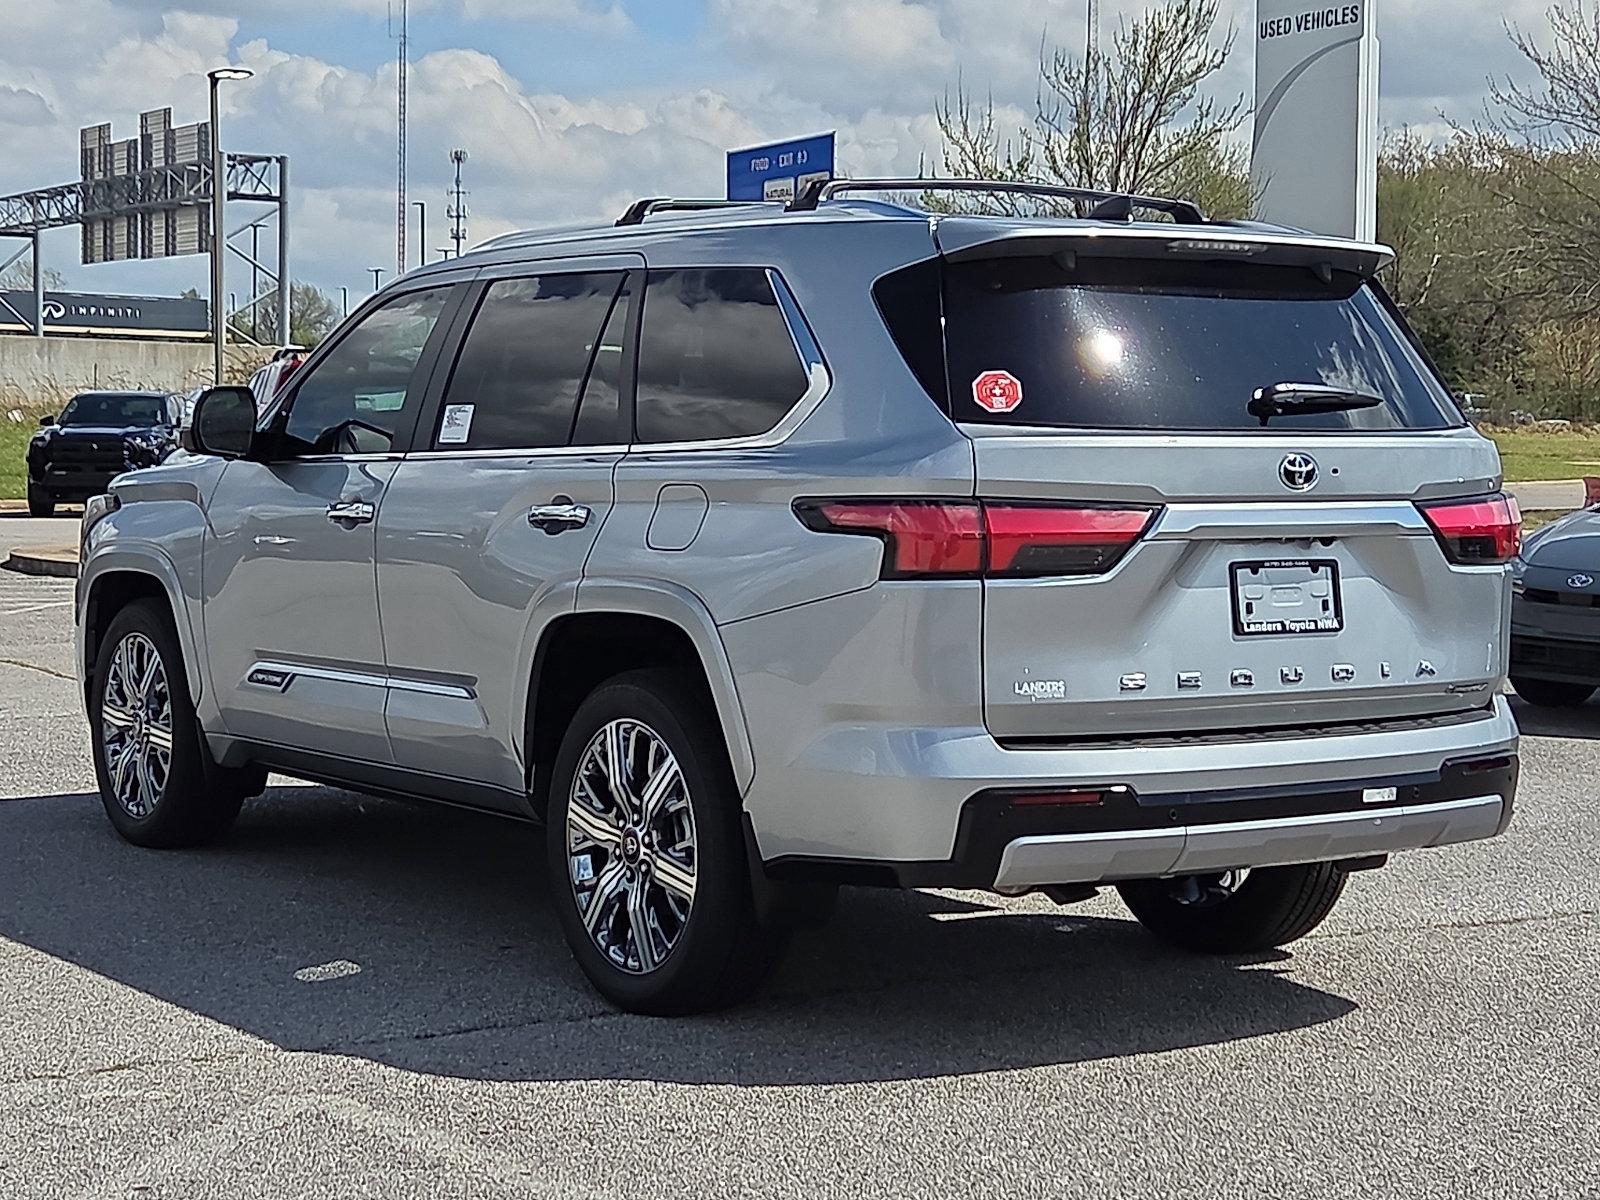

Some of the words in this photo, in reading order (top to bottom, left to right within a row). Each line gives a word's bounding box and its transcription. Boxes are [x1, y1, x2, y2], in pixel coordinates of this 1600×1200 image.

[1260, 17, 1292, 39] USED
[1295, 5, 1359, 32] VEHICLES
[70, 305, 142, 319] INFINITI
[1243, 621, 1282, 633] Landers
[1283, 620, 1316, 633] Toyota
[1317, 618, 1340, 630] NWA
[1118, 659, 1437, 692] SEQUOIA
[1014, 680, 1066, 695] LANDERS
